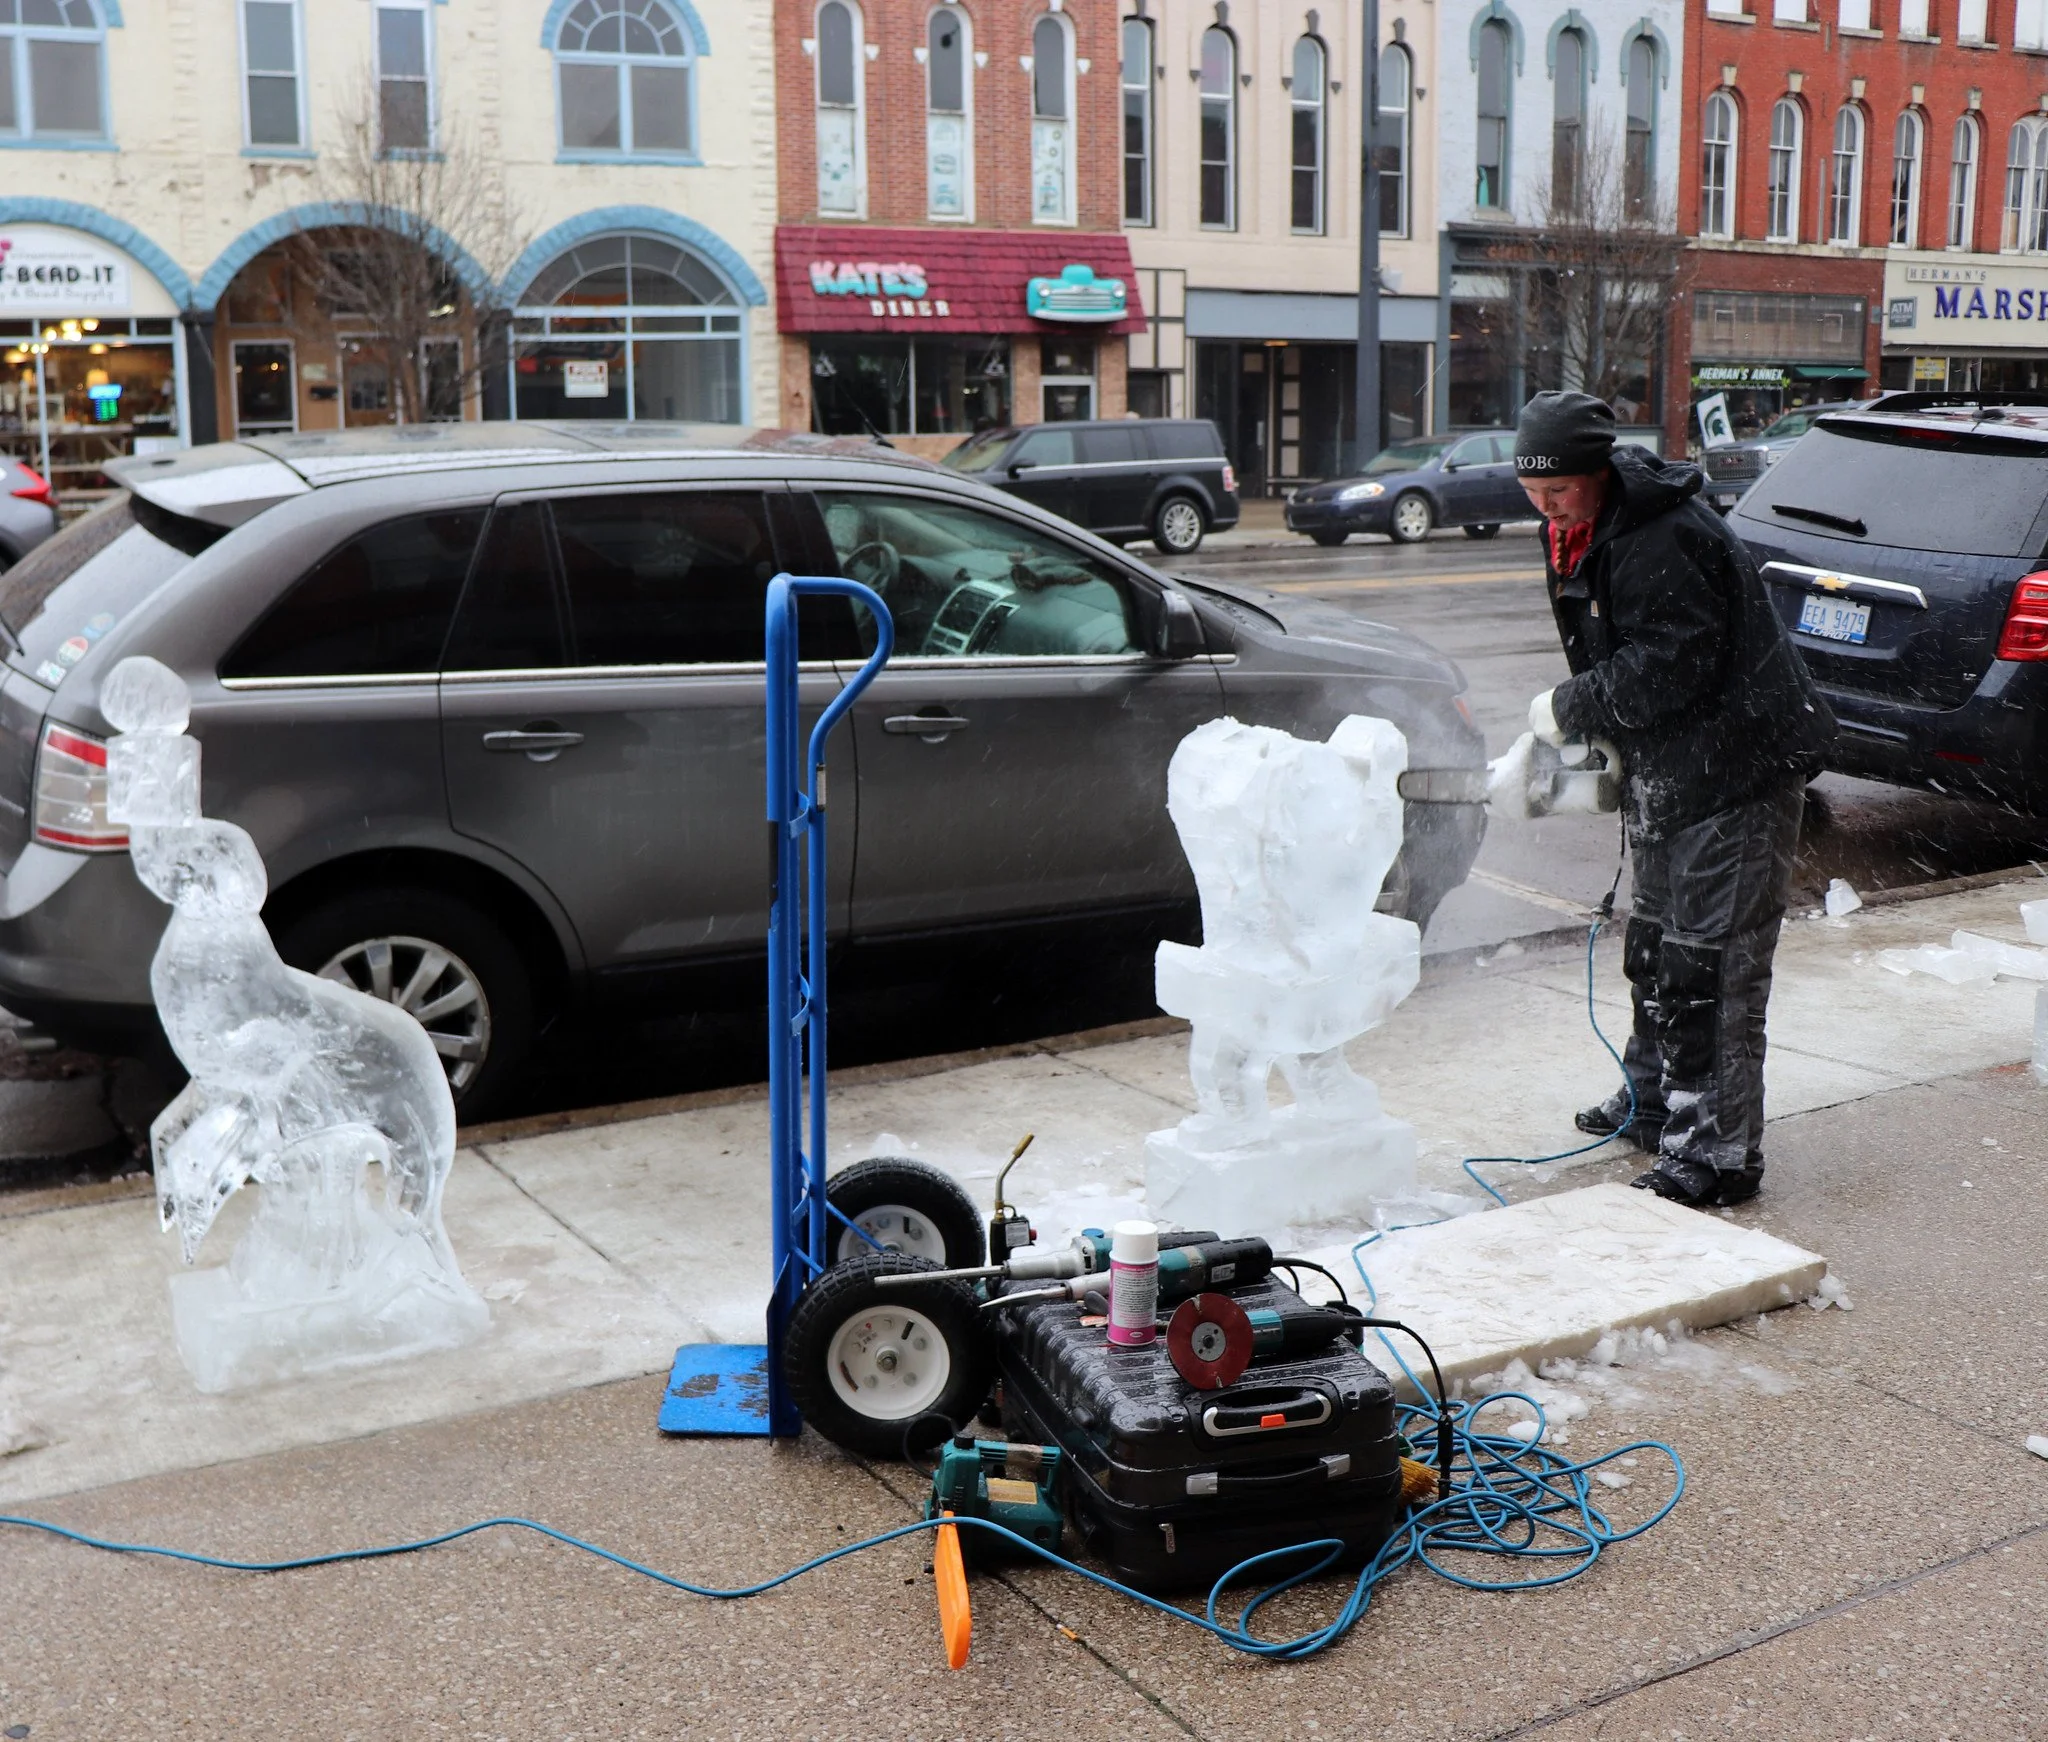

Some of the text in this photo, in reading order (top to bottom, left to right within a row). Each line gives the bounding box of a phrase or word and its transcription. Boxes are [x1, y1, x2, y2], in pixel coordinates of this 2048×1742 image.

[809, 260, 928, 298] KATE'S
[1909, 267, 1987, 282] HERMAN'S
[870, 300, 949, 317] DINER
[1891, 302, 1913, 313] ATM
[1751, 368, 1784, 381] ANNEX
[1516, 455, 1560, 469] XOBC
[1803, 604, 1866, 633] EEA 9479
